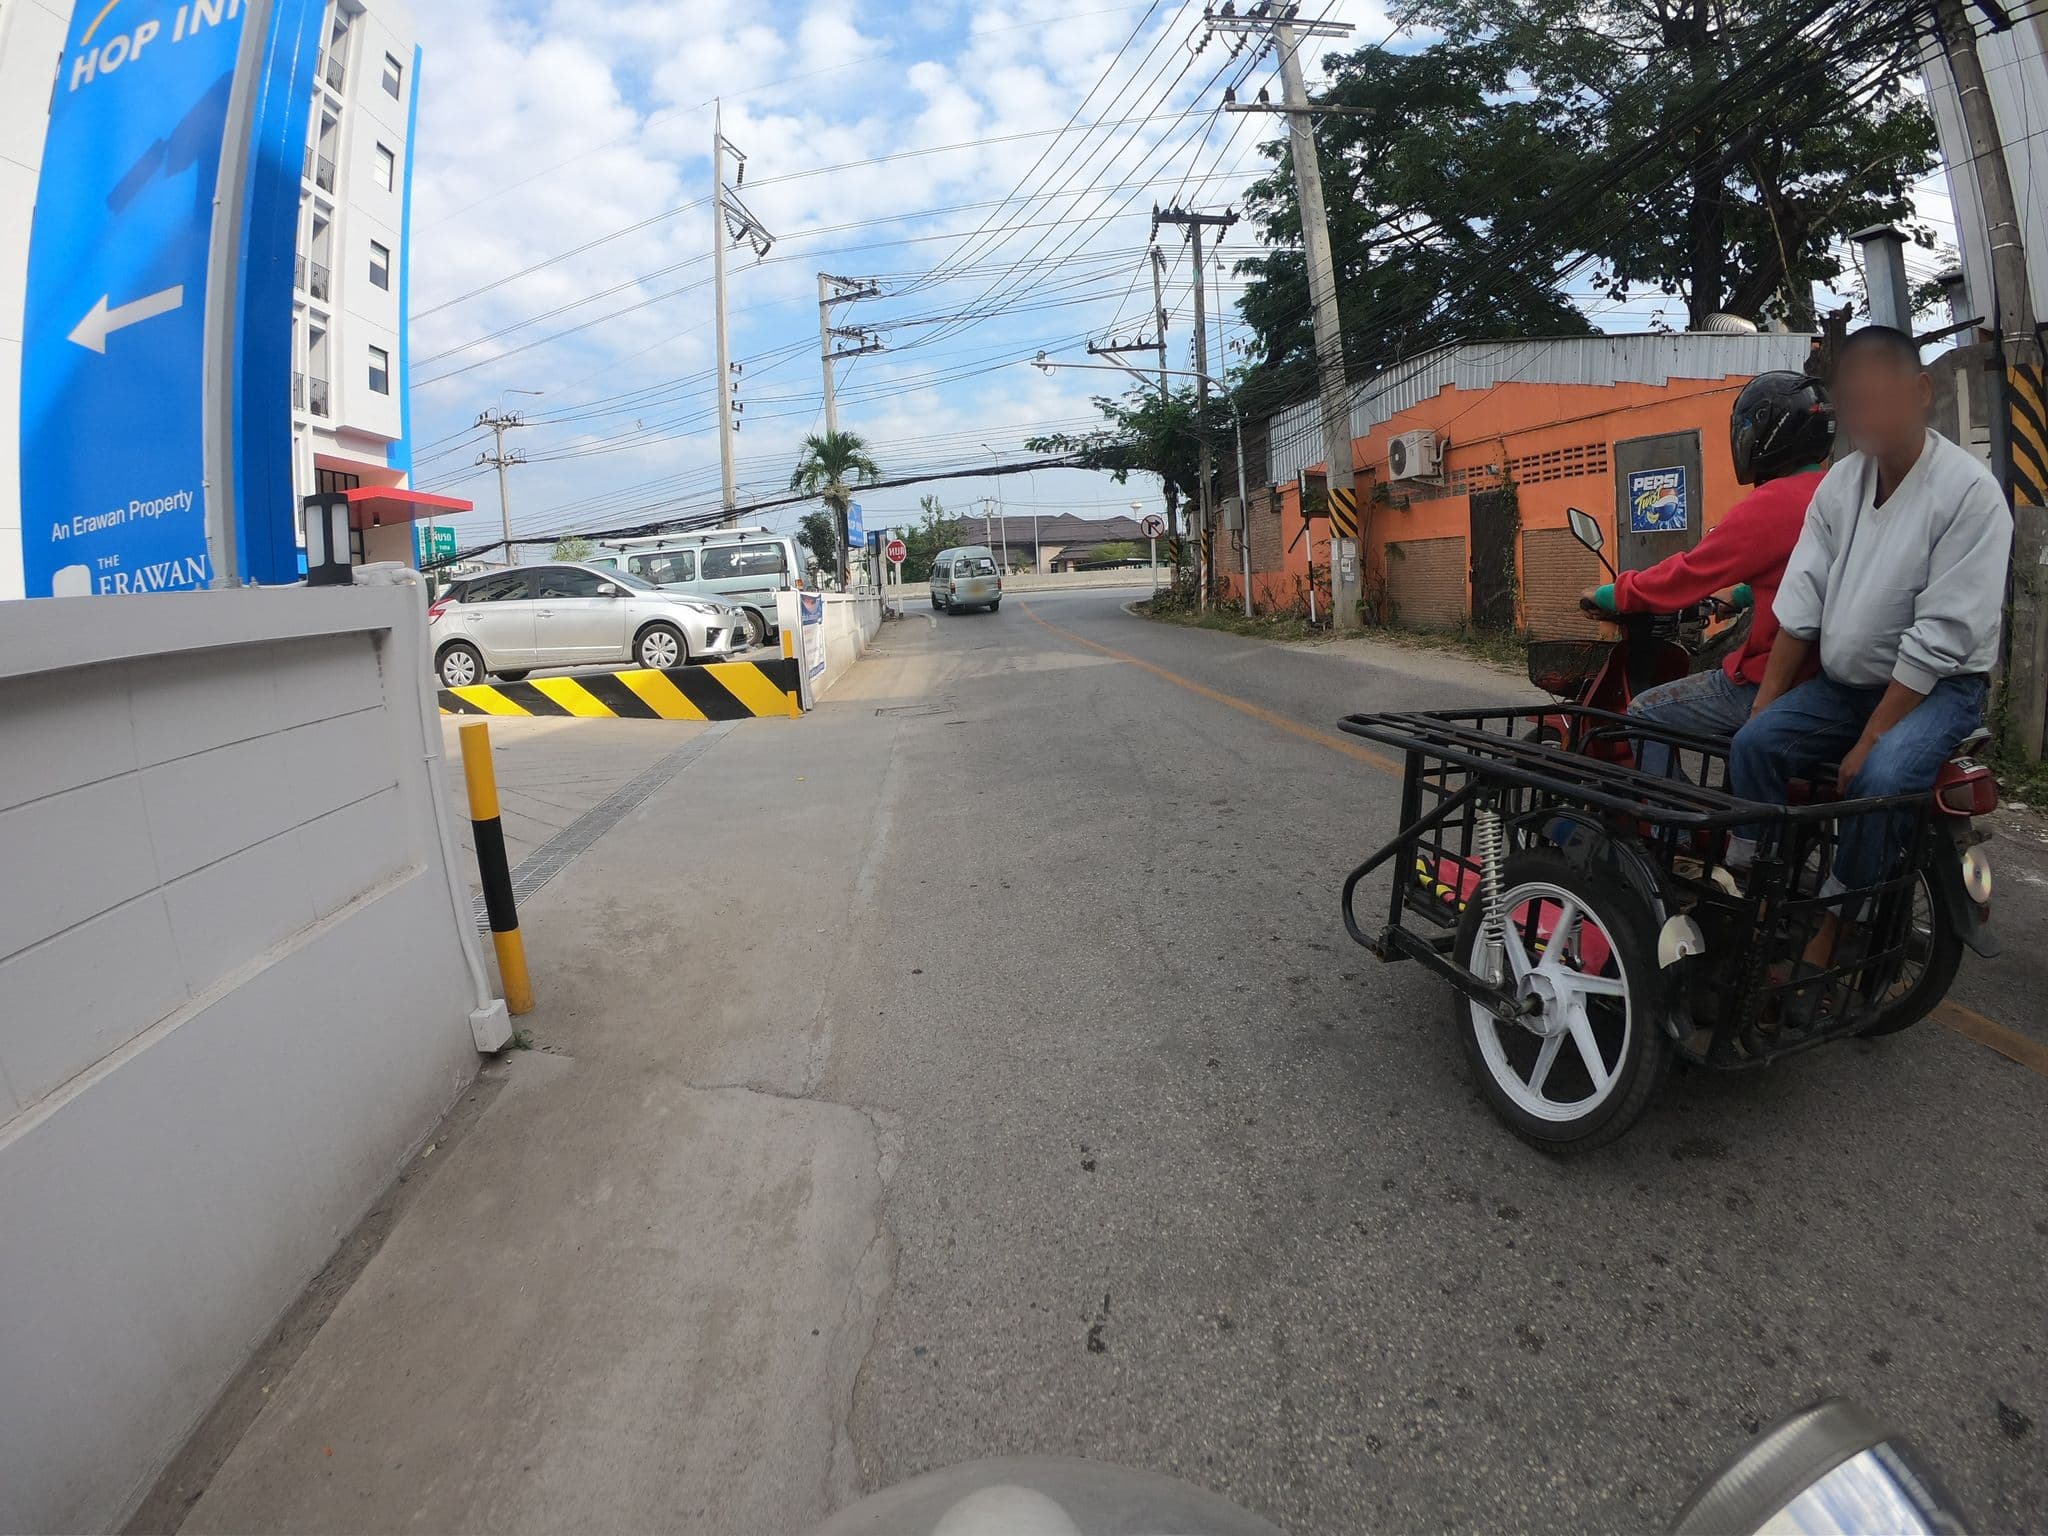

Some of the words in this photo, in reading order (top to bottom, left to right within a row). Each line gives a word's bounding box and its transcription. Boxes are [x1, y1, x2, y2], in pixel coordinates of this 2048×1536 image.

[69, 20, 160, 92] HOP
[1633, 474, 1679, 491] PEPSI
[52, 523, 70, 542] An
[73, 509, 126, 536] Erawan
[129, 489, 194, 520] Property
[98, 554, 120, 570] THE
[98, 554, 208, 595] ERAWAN
